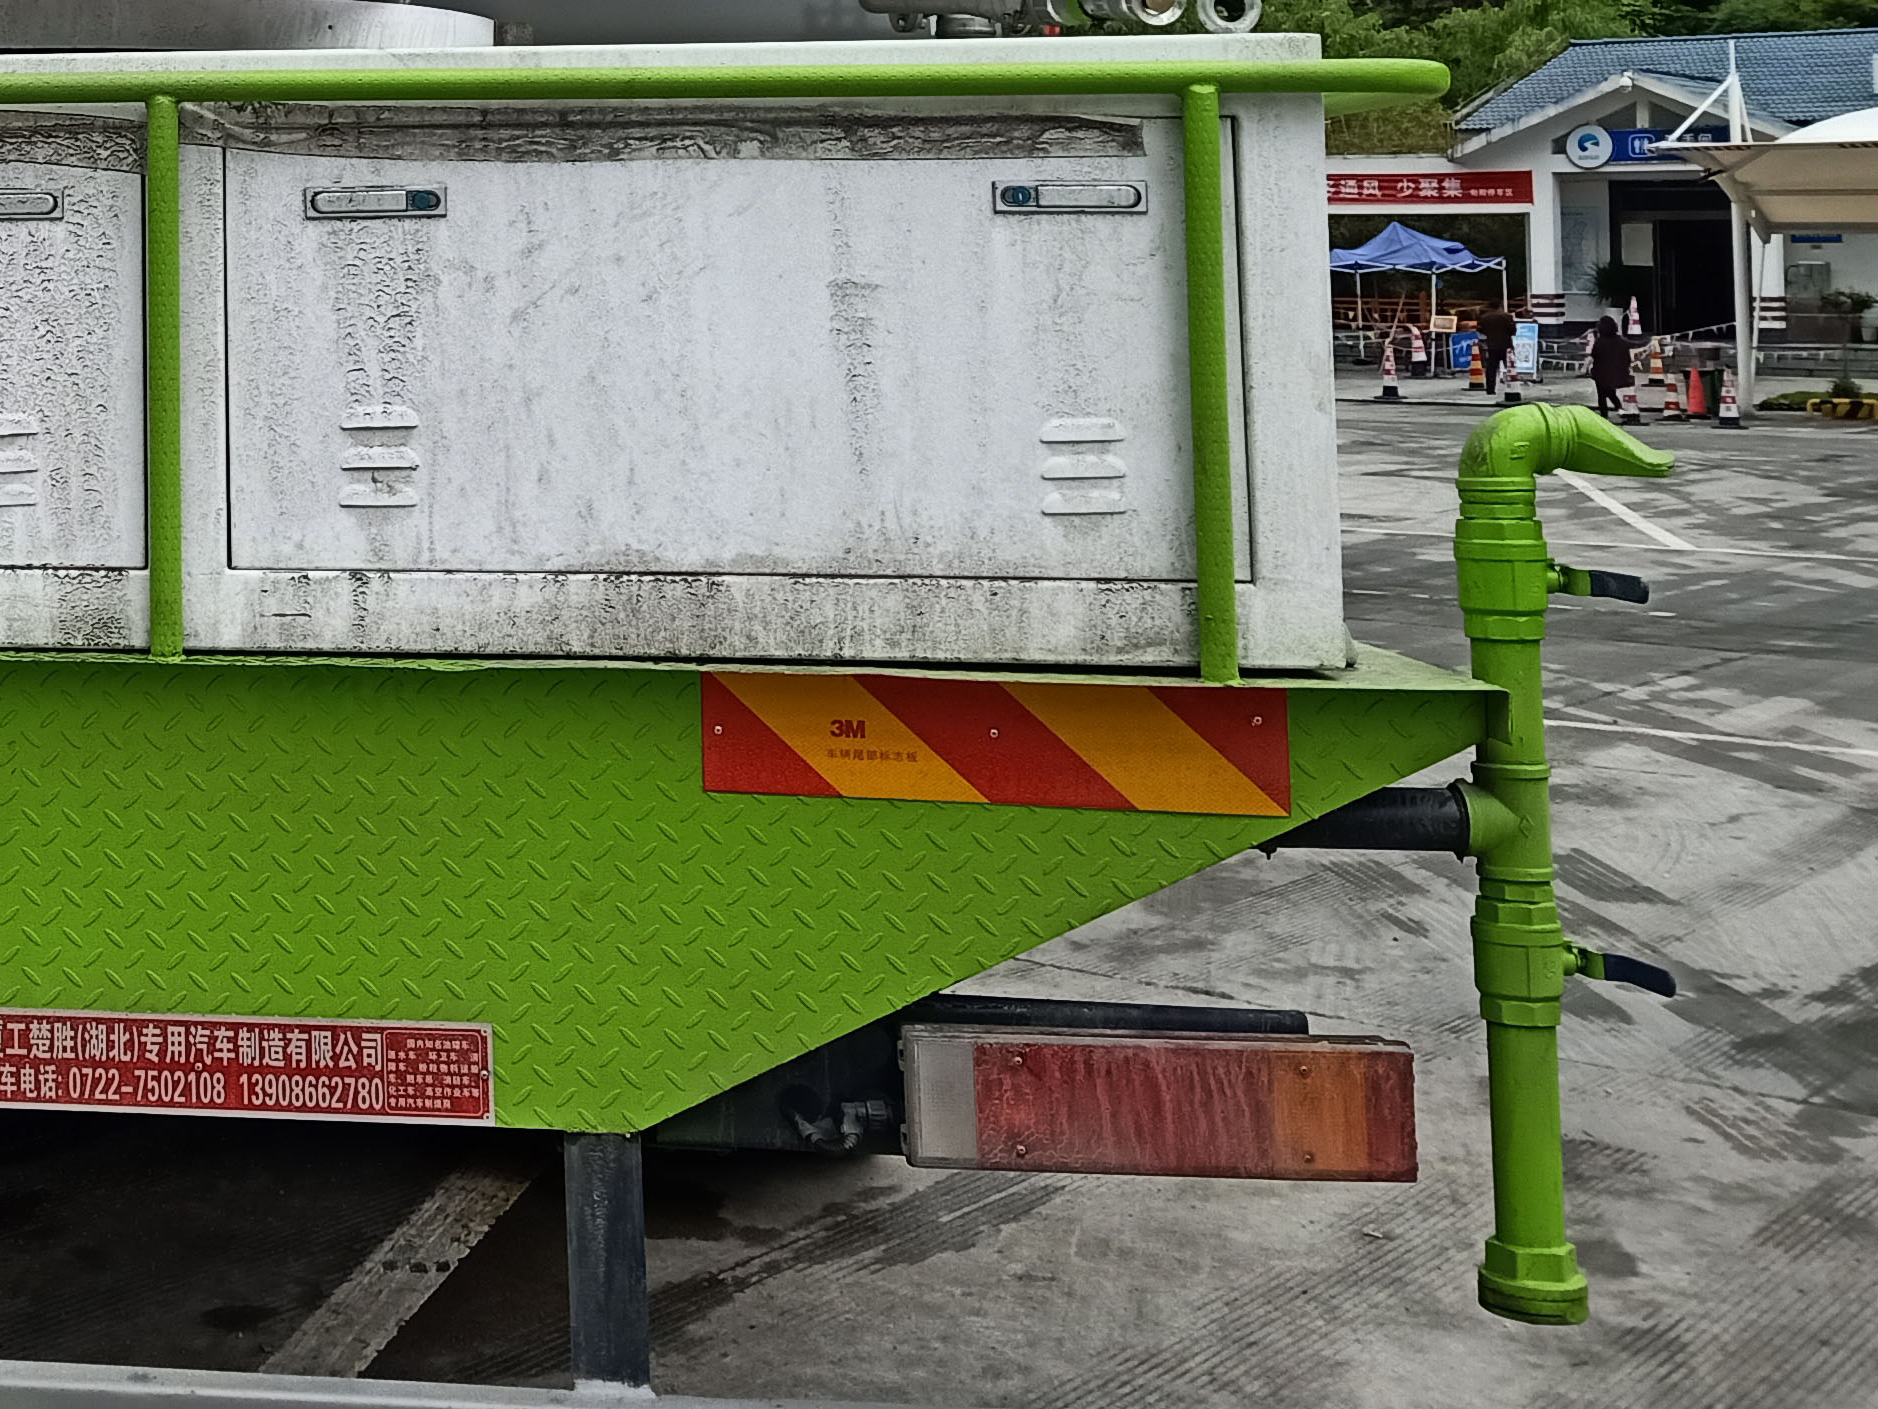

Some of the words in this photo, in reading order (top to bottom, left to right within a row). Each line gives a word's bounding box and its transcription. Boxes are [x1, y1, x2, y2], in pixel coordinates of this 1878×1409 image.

[830, 719, 866, 739] 3M
[68, 1067, 225, 1104] 0722-7502108
[239, 1073, 383, 1111] 13908662780
